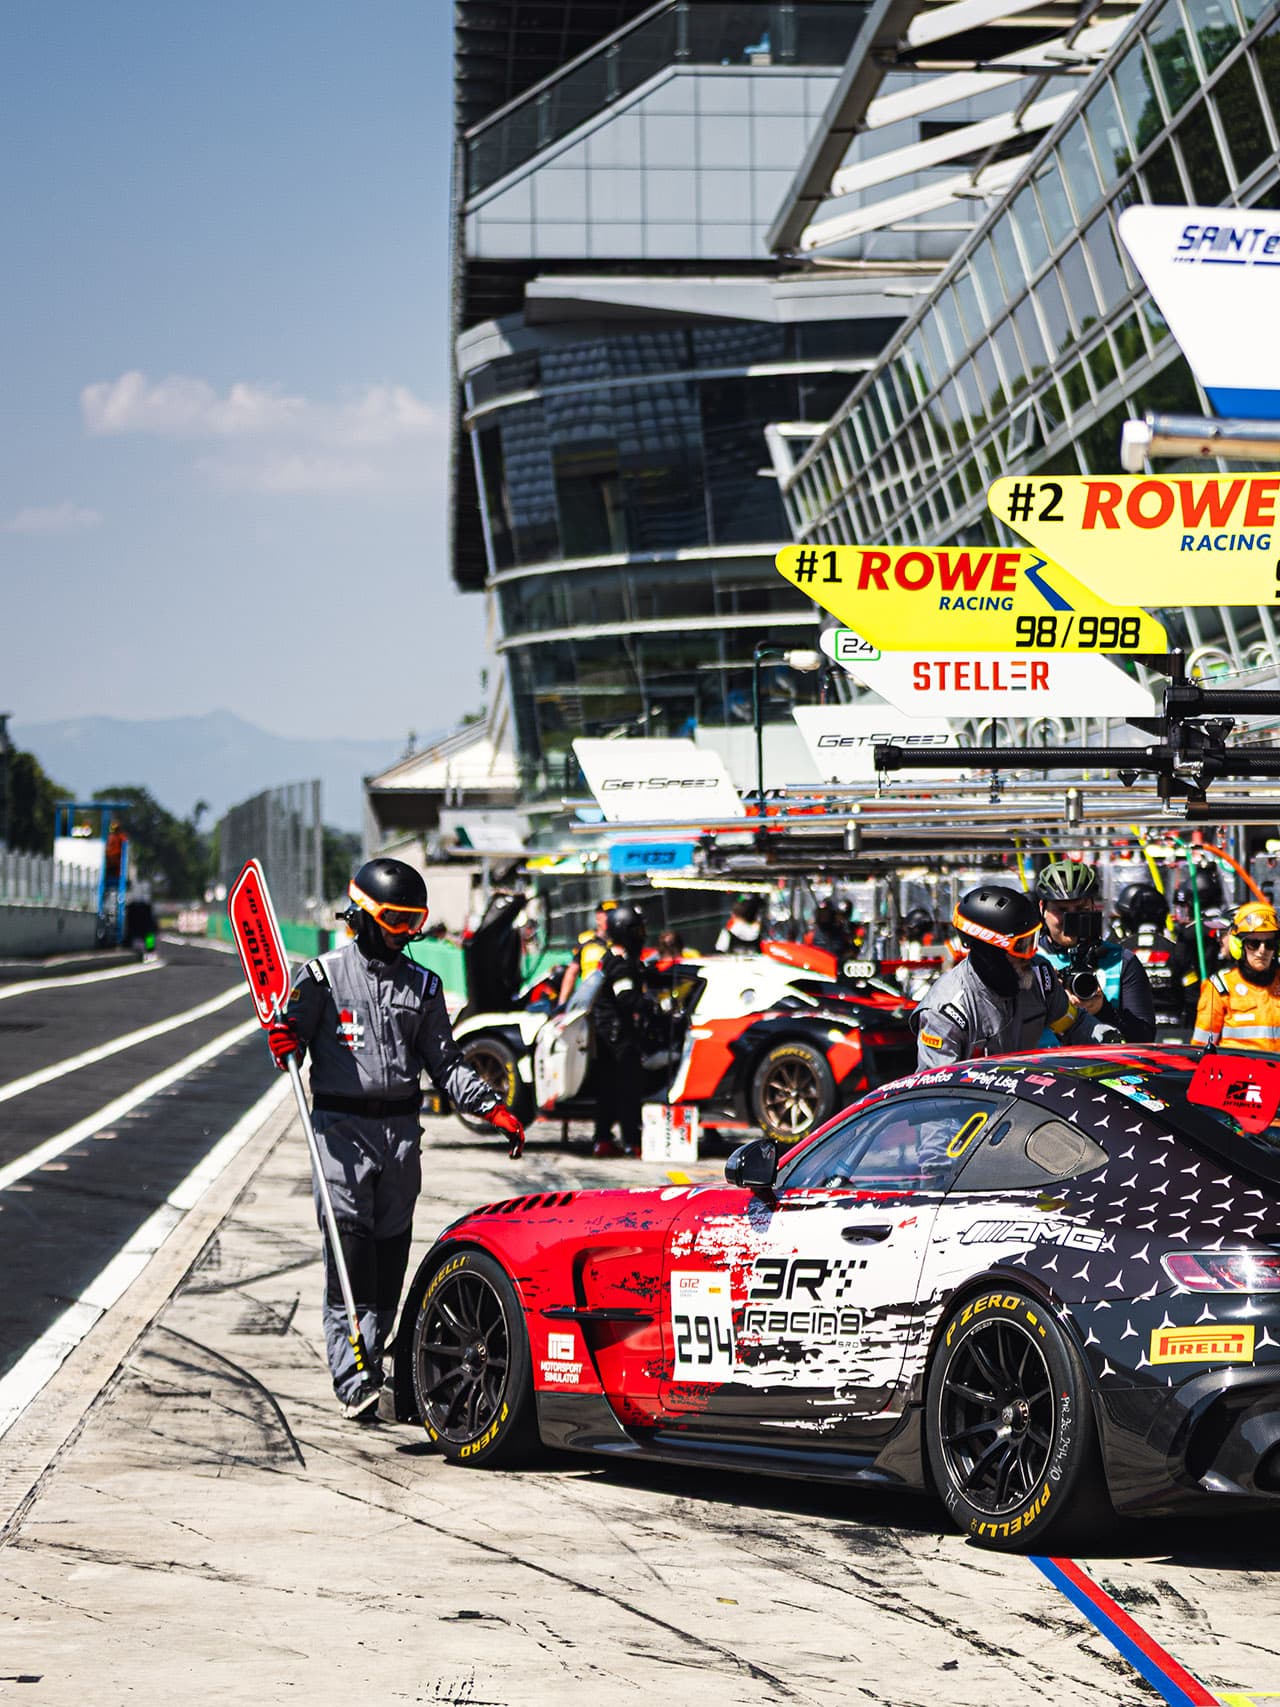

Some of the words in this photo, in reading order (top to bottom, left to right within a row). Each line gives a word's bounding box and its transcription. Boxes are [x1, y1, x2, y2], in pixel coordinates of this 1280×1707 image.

[1007, 482, 1064, 522] #2
[1081, 478, 1280, 529] ROWE
[1180, 533, 1272, 552] RACING
[795, 550, 842, 583] #1
[857, 551, 1021, 592] ROWE
[939, 596, 1014, 611] RACING
[843, 638, 874, 653] 24
[913, 661, 1050, 692] STELLER
[961, 920, 1010, 949] 100%
[242, 920, 269, 987] STOP
[960, 1294, 1020, 1327] ZERO
[674, 1315, 732, 1365] 294
[1159, 1333, 1245, 1356] PIRELLI
[541, 1361, 582, 1373] MOTORSPORT
[544, 1371, 580, 1385] SIMULATOR
[461, 1423, 499, 1457] ZERO
[978, 1482, 1051, 1538] PIRELLI
